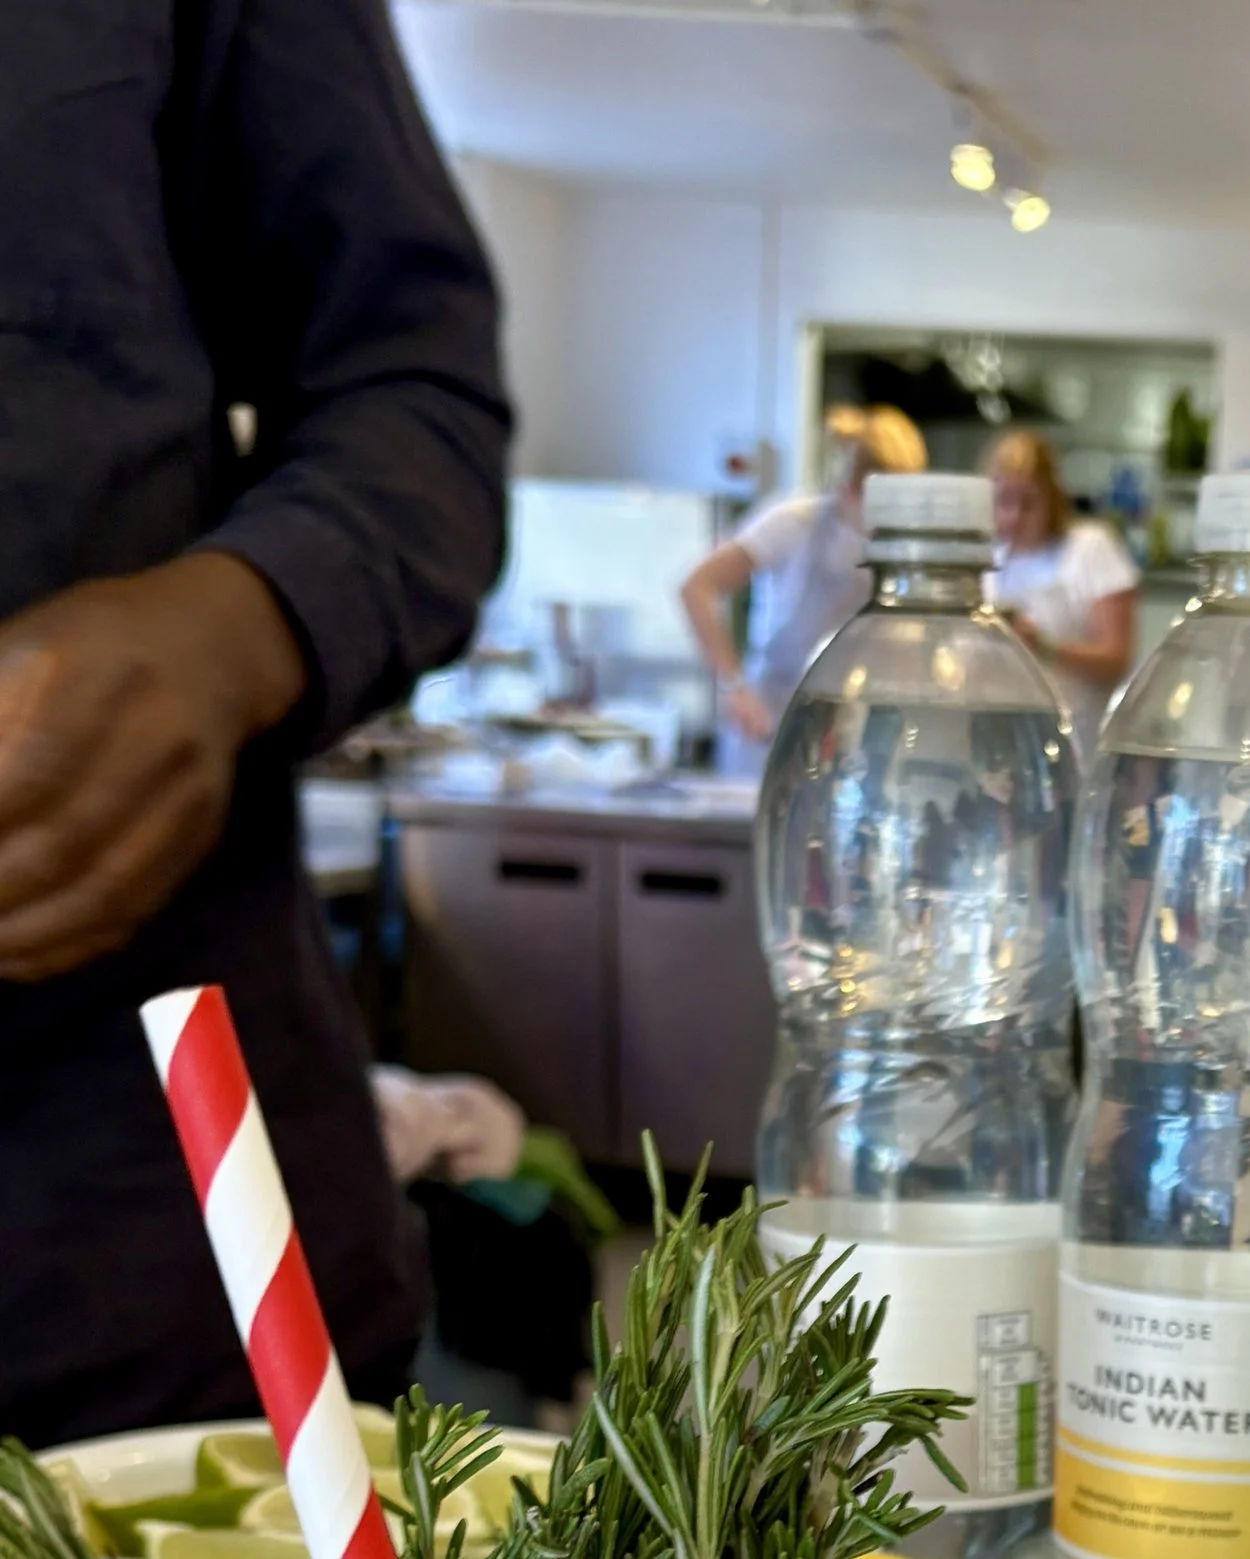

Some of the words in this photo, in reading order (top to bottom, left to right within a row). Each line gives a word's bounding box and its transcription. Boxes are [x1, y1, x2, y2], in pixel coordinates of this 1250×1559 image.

[1095, 1308, 1213, 1341] WAITROSE
[1066, 1382, 1136, 1424] TONIC
[1094, 1364, 1207, 1403] INDIAN
